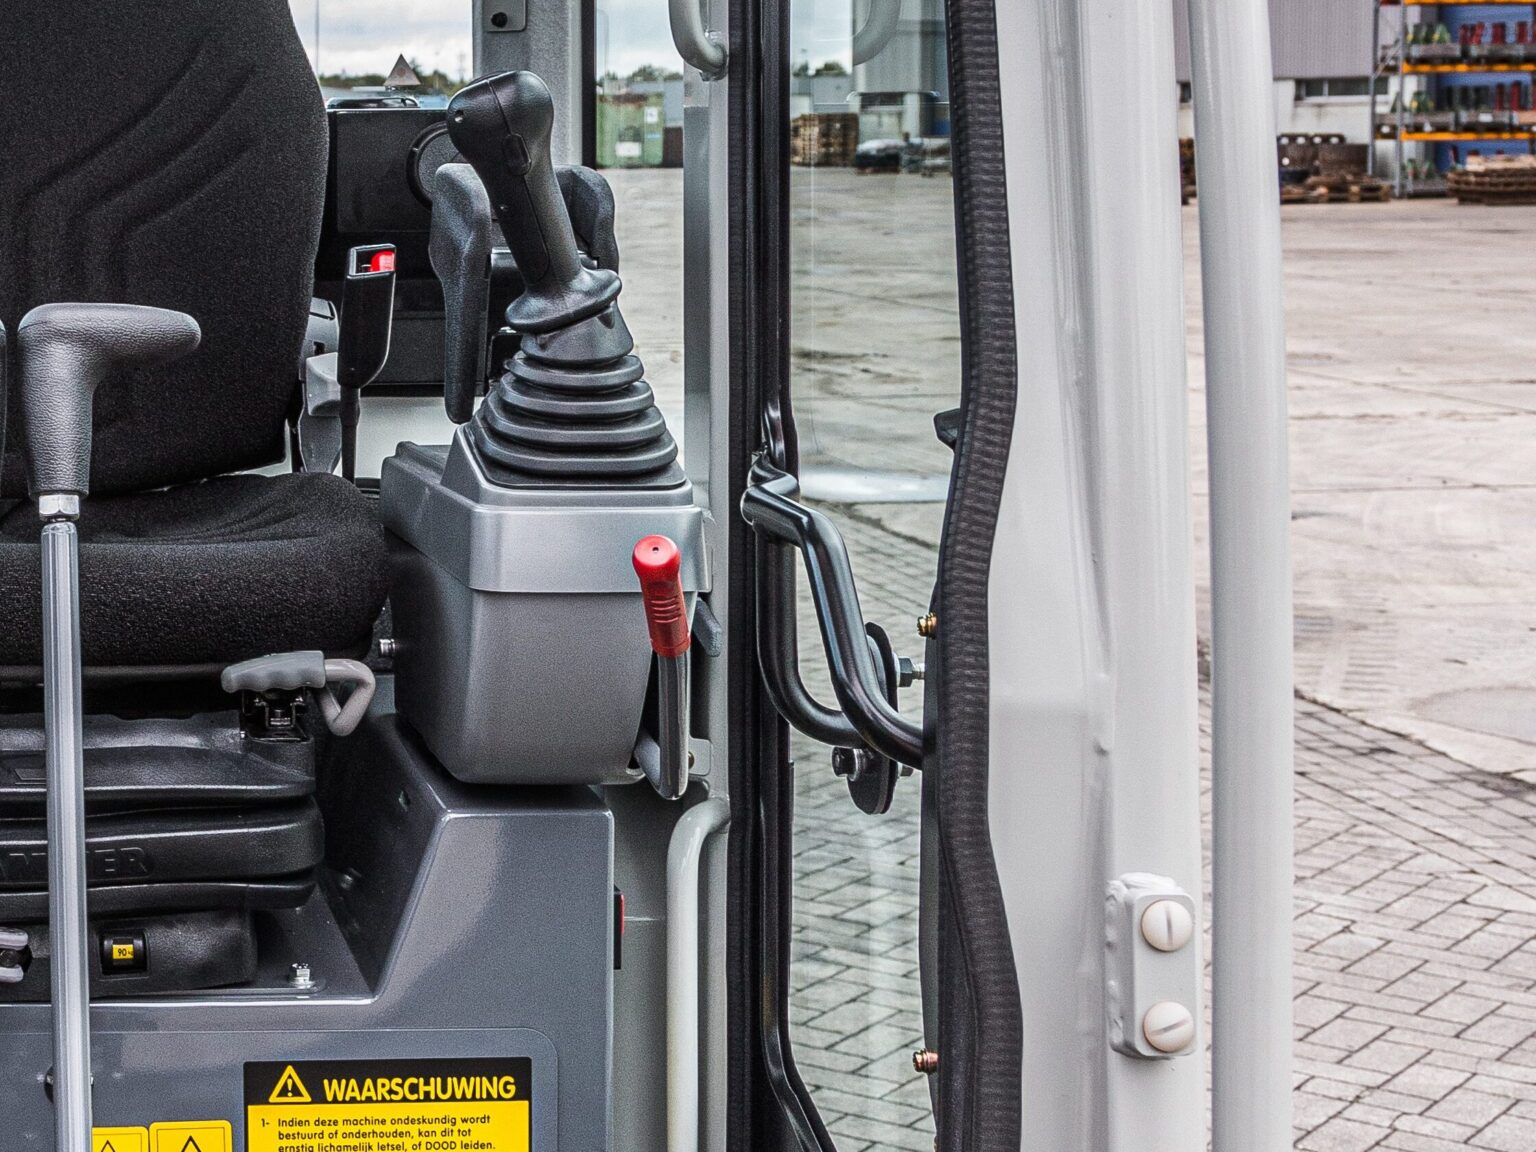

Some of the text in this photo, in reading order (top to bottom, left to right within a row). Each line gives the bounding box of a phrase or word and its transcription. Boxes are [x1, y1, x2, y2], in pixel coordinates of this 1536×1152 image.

[117, 948, 128, 957] 90
[323, 1075, 517, 1102] WAARSCHUWING
[277, 1117, 311, 1127] Indien
[314, 1116, 339, 1127] deze
[342, 1115, 387, 1127] machine
[390, 1115, 457, 1127] ondeskundig
[460, 1114, 491, 1124] wordt
[277, 1127, 472, 1141] bestuurd of onderhouden, kan dit tot
[278, 1140, 496, 1152] ernstig lichamelijk letsel, of DOOD leiden.
